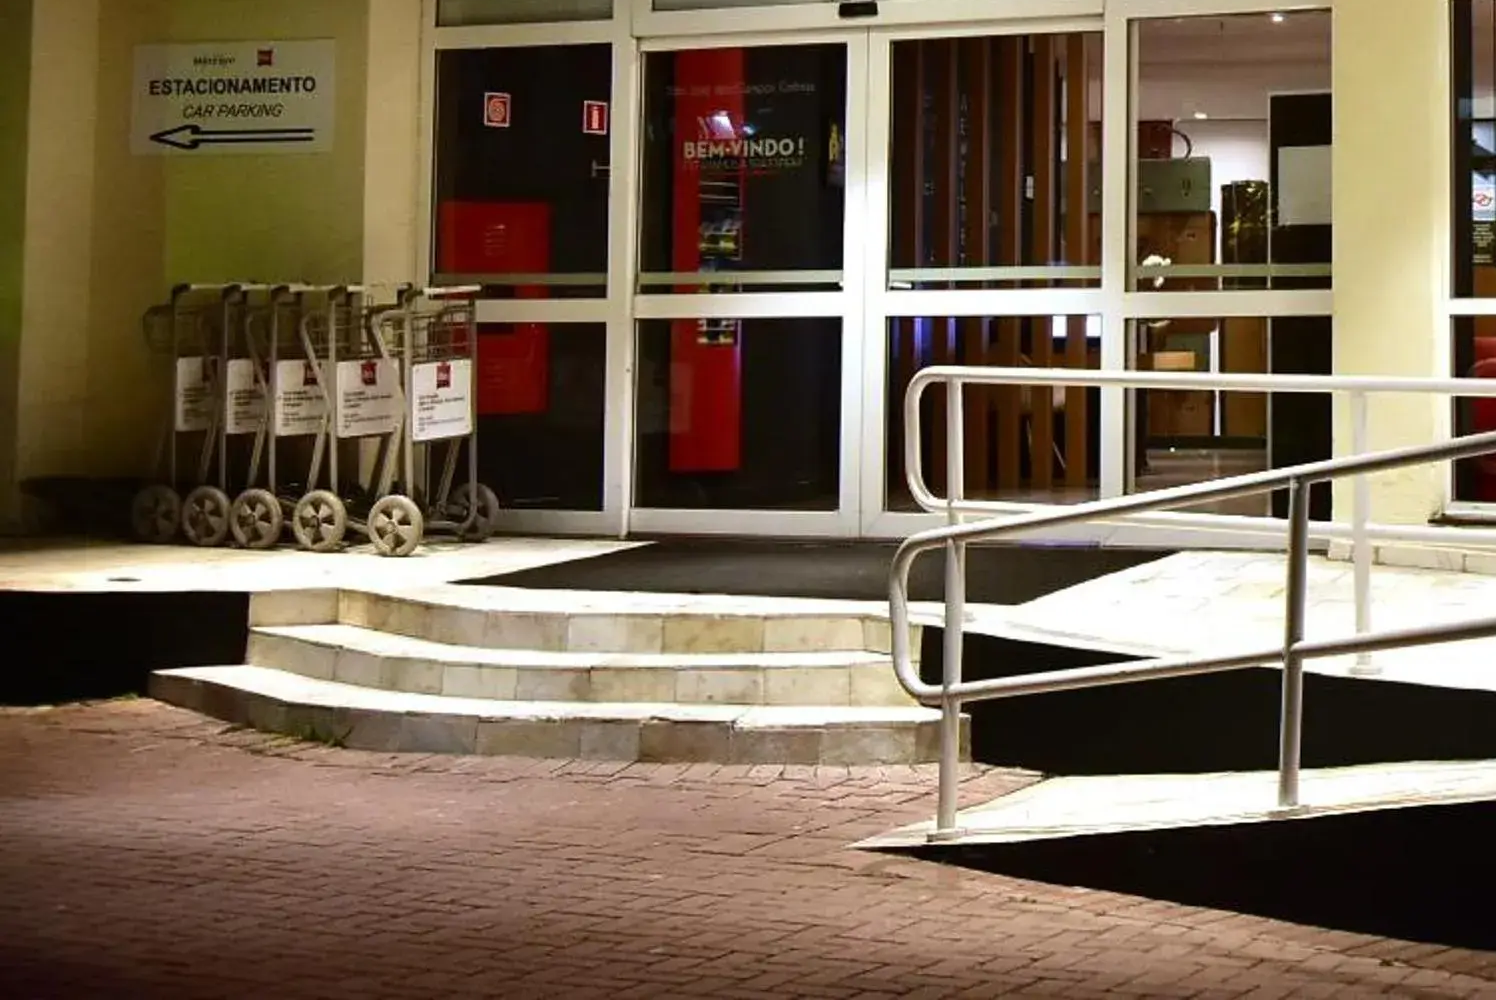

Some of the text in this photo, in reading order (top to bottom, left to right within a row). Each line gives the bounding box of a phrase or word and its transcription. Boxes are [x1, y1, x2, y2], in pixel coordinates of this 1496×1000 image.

[149, 76, 316, 96] ESTACIONAMENTO
[182, 103, 285, 119] CAR PARKING
